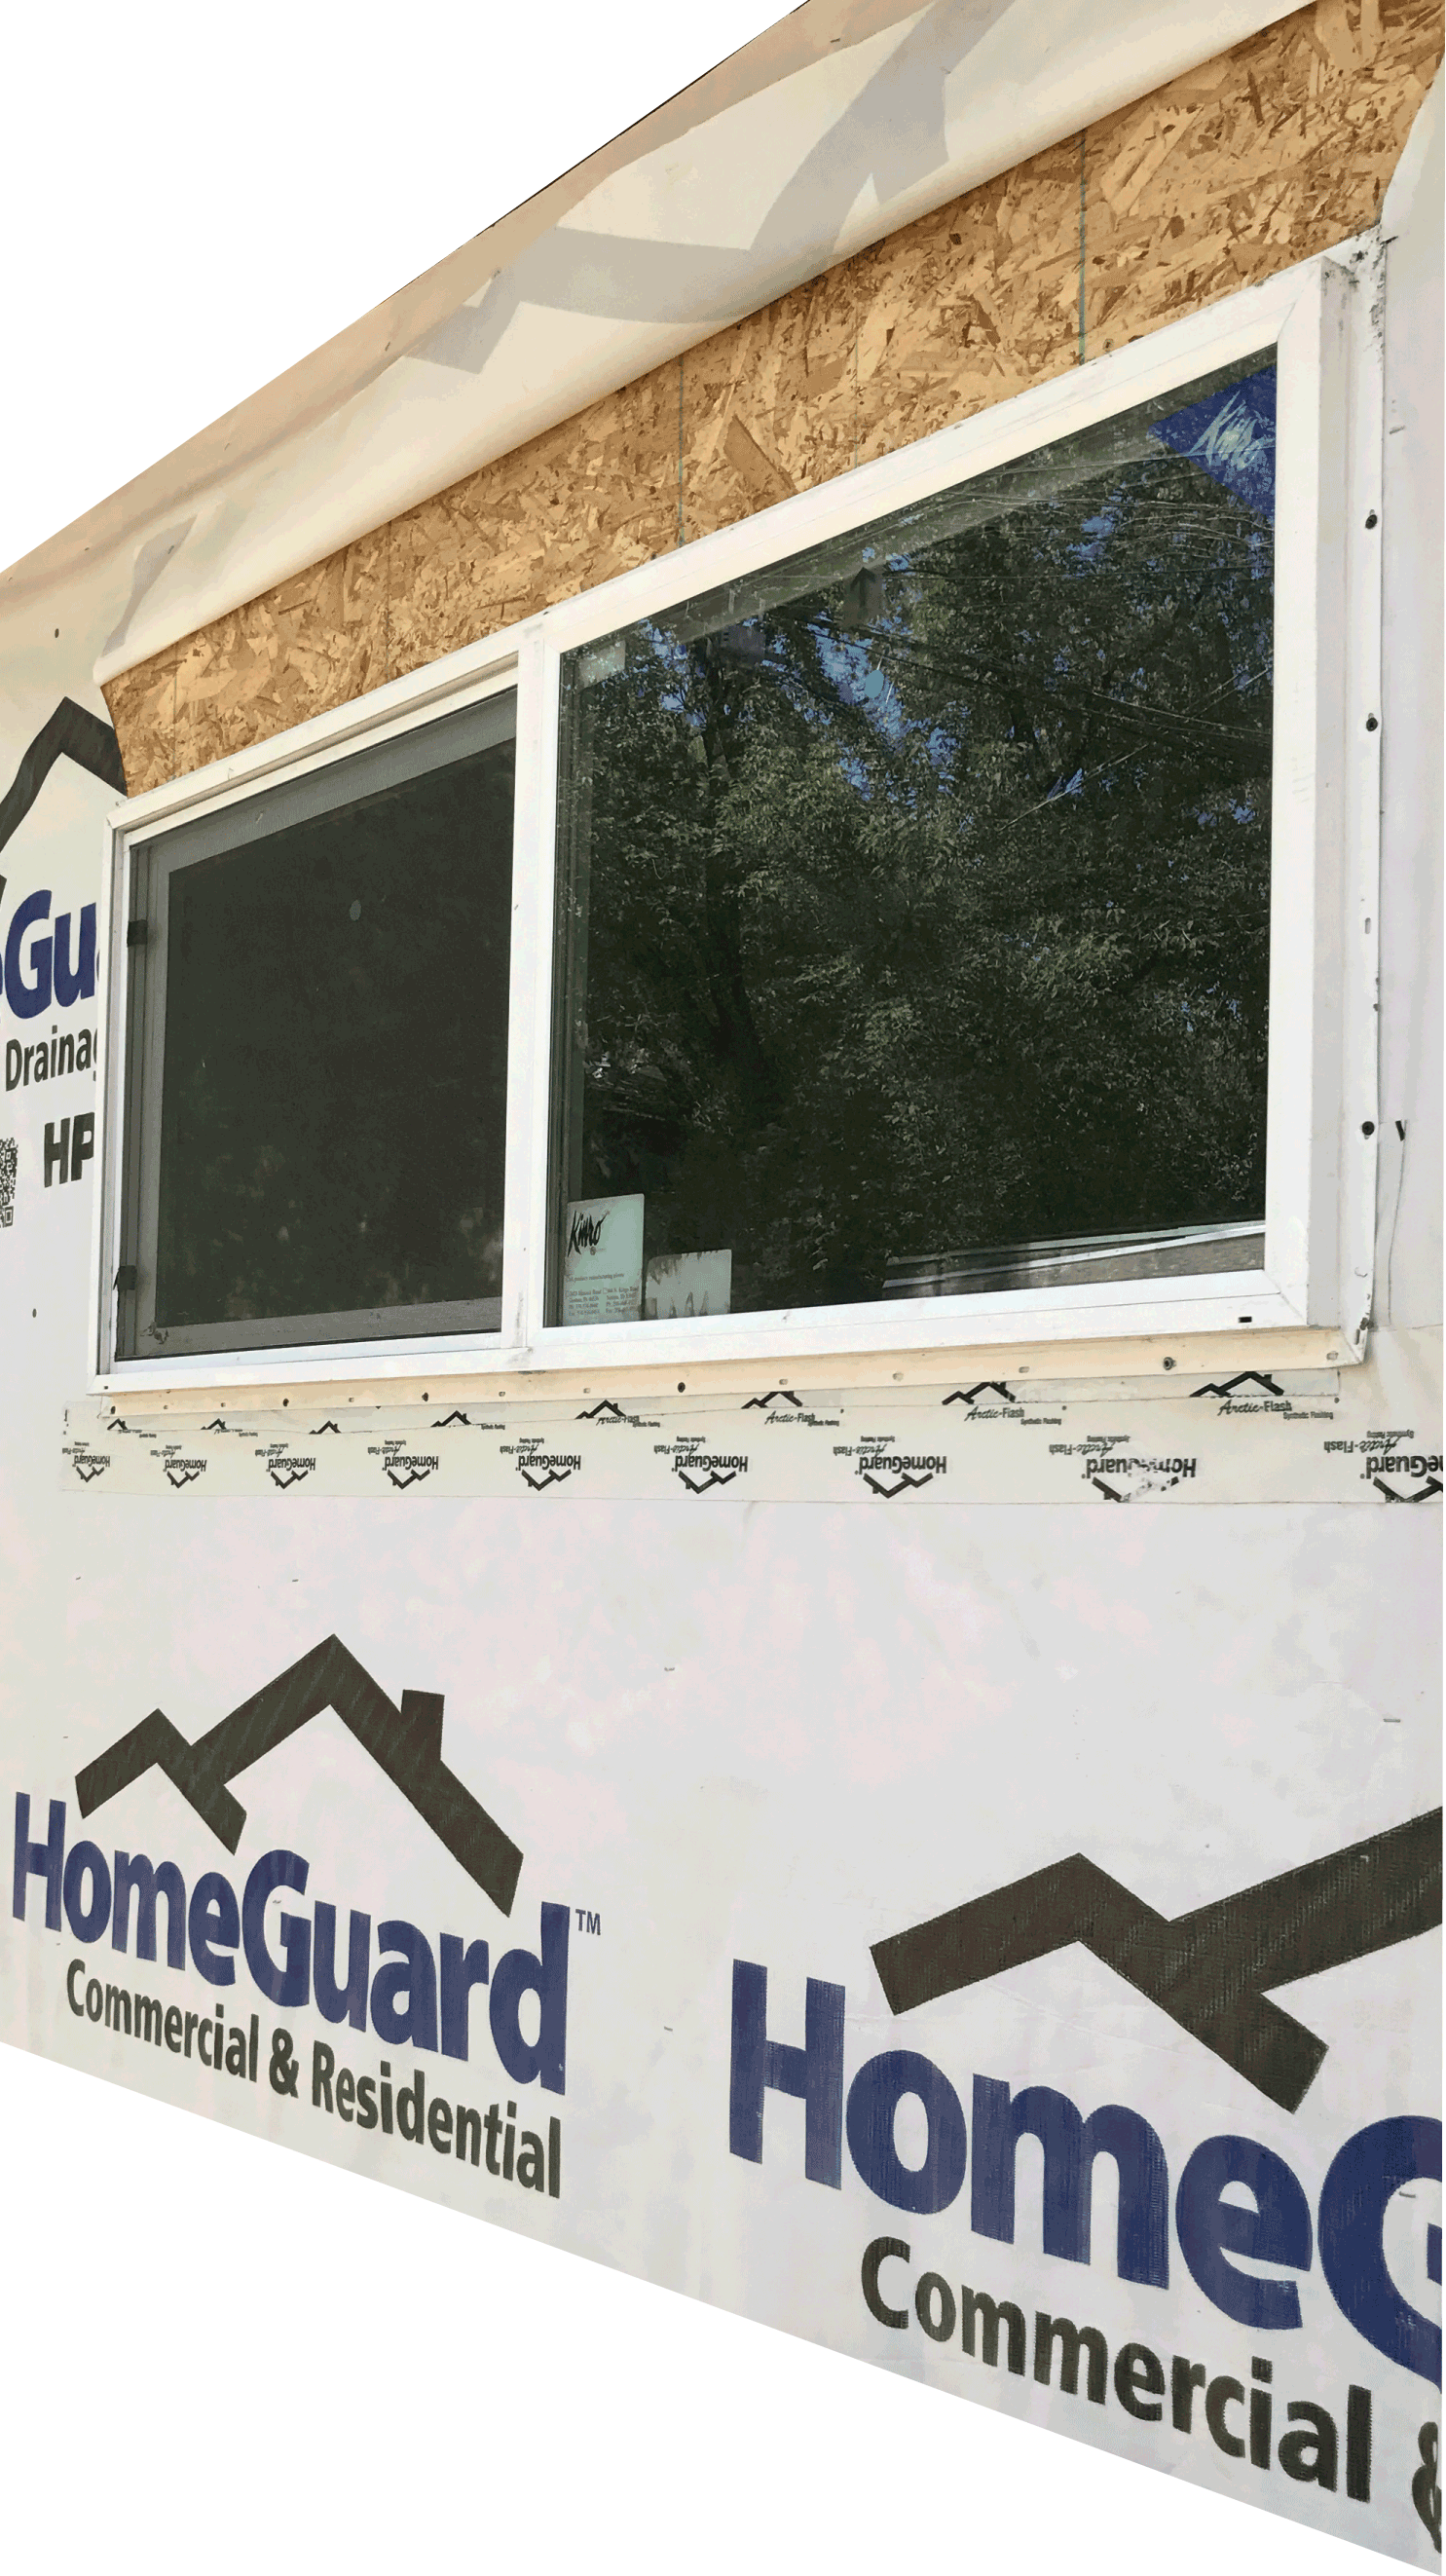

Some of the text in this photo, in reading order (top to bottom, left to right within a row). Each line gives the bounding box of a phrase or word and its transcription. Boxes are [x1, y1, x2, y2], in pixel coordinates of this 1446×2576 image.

[0, 888, 100, 1019] Gu
[6, 1026, 97, 1091] Draina
[964, 1405, 1024, 1421] Arctic-Flash
[1217, 1400, 1292, 1416] Arctic-Flash
[1049, 1444, 1113, 1457] Arctic-Flash
[1324, 1440, 1396, 1455] Arctic-Flash
[268, 1458, 315, 1472] HomeGuard
[385, 1456, 439, 1471] HomeGuard
[517, 1455, 581, 1471] HomeGuard
[675, 1455, 748, 1472] HomeGuard
[859, 1456, 946, 1475] HomeGuard
[1365, 1455, 1443, 1479] eGuard
[13, 1791, 571, 2096] HomeGuard
[67, 1959, 561, 2199] Commercial & Residential
[861, 2236, 1372, 2504] Commercial
